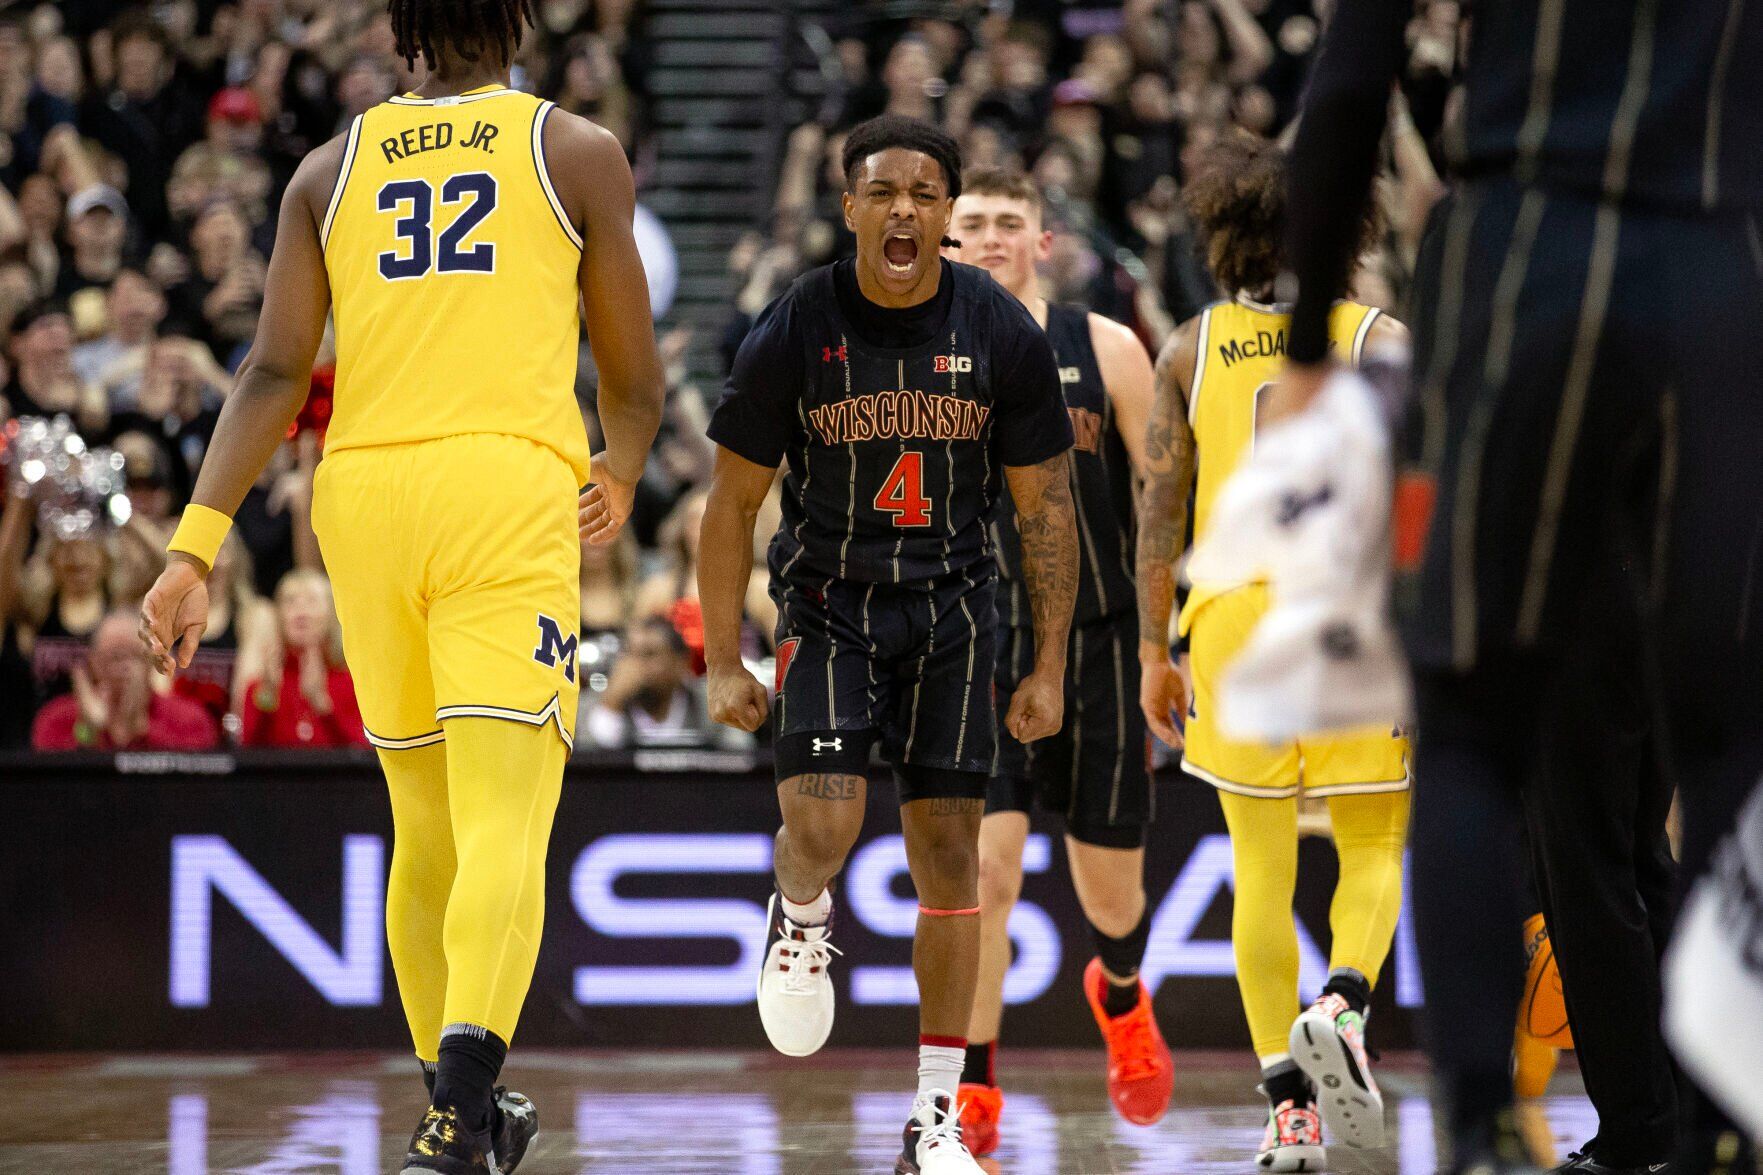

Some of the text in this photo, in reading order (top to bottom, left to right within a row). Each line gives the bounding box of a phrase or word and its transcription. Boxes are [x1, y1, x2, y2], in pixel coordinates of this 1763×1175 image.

[380, 120, 499, 164] REED JR.
[376, 170, 498, 282] 32
[809, 390, 989, 445] WISCONSIN
[873, 451, 932, 527] 4
[533, 612, 578, 685] M
[798, 774, 857, 799] RISE
[170, 834, 1425, 1006] NSSA
